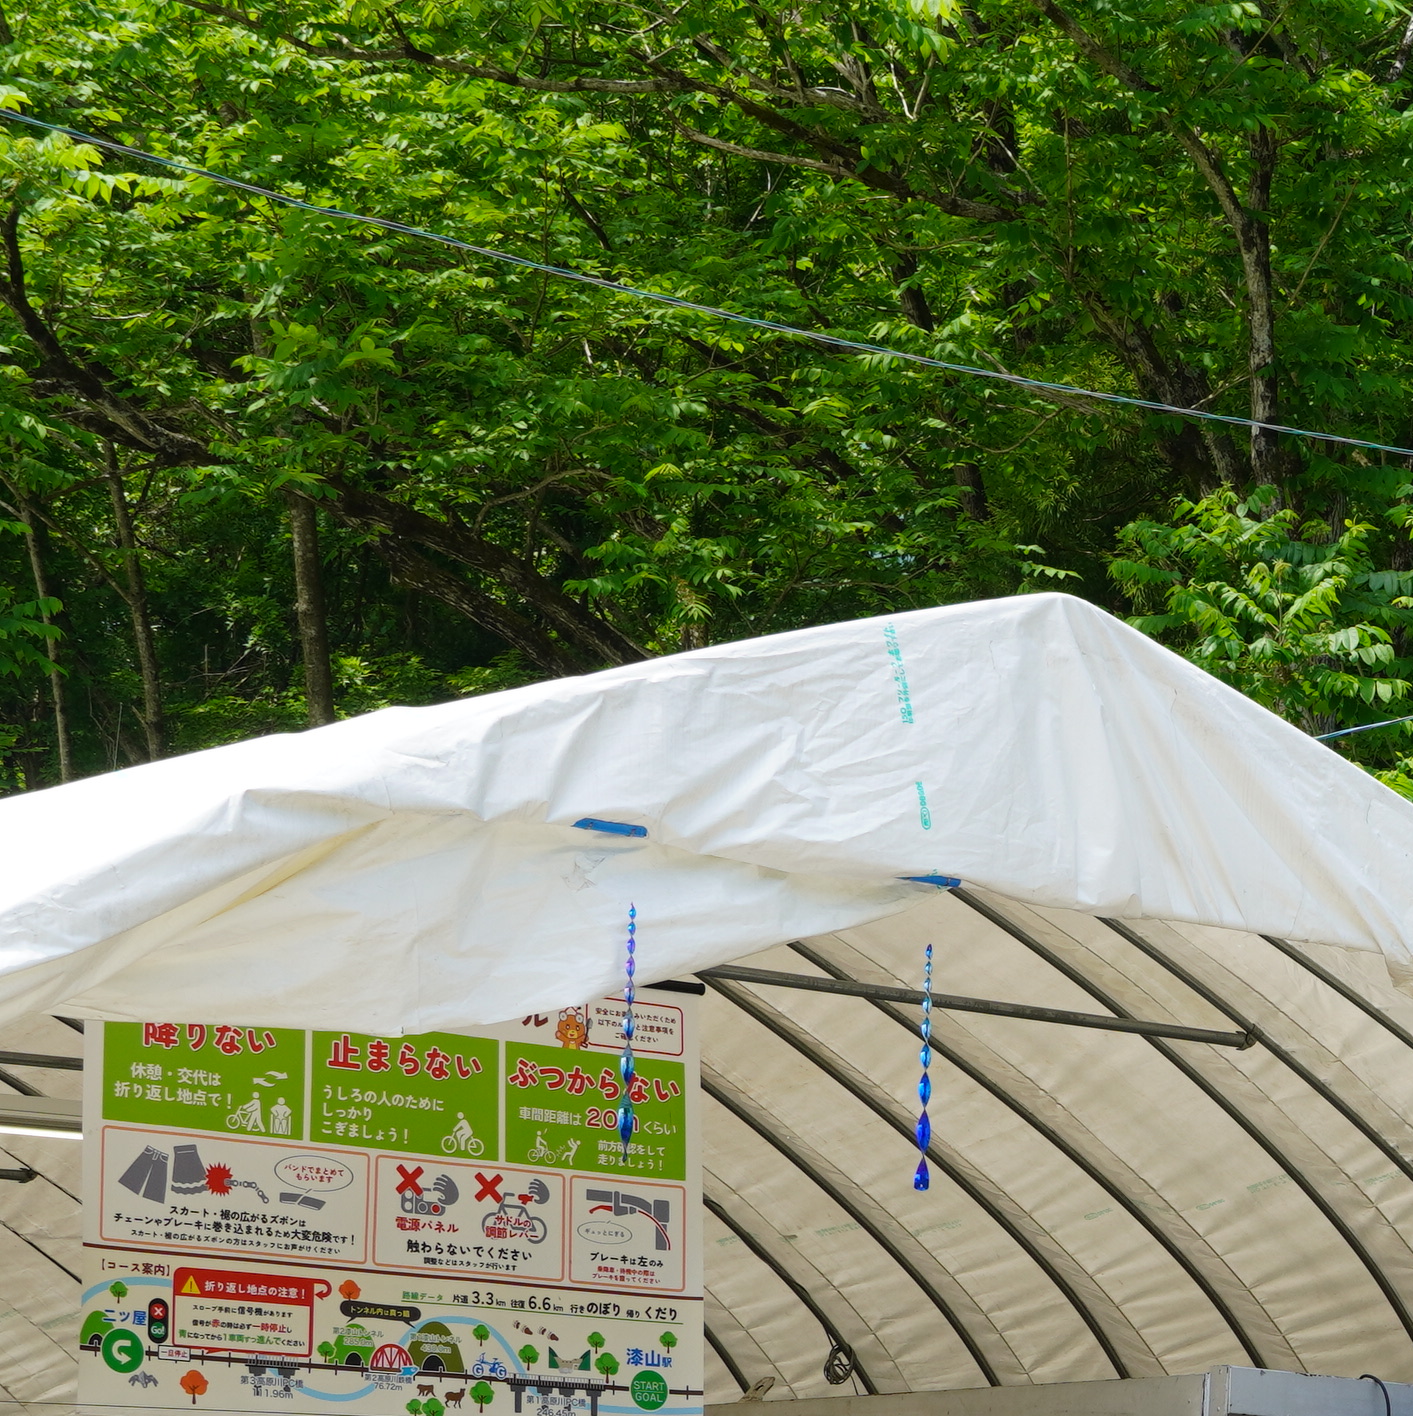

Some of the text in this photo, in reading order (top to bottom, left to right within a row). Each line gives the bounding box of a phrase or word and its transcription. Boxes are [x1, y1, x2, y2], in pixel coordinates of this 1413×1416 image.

[142, 1022, 277, 1054] 降りない
[327, 1035, 482, 1080] 止まらない
[130, 1062, 222, 1087] 休憩・交代は
[508, 1059, 681, 1104] ぶつからない
[322, 1084, 445, 1111] うしろの人のために
[322, 1102, 373, 1121] しっかり
[519, 1106, 677, 1135] 車間距離は くらい
[296, 1173, 334, 1183] もらいます
[169, 1205, 307, 1227] スカート・裾の広がるズボンは
[395, 1216, 460, 1234] 電源パネル
[494, 1215, 531, 1228] サドルの
[485, 1225, 539, 1240] 調節レバー
[406, 1239, 533, 1261] 触わらないでください
[423, 1256, 518, 1272] 調整などはスタッフが行います
[590, 1251, 664, 1268] ブレーキは左のみ
[402, 1290, 443, 1302] 路線データ
[150, 1324, 166, 1335] Go!
[626, 1347, 673, 1368] 漆山駅
[633, 1380, 665, 1391] START
[635, 1391, 664, 1403] GOAL
